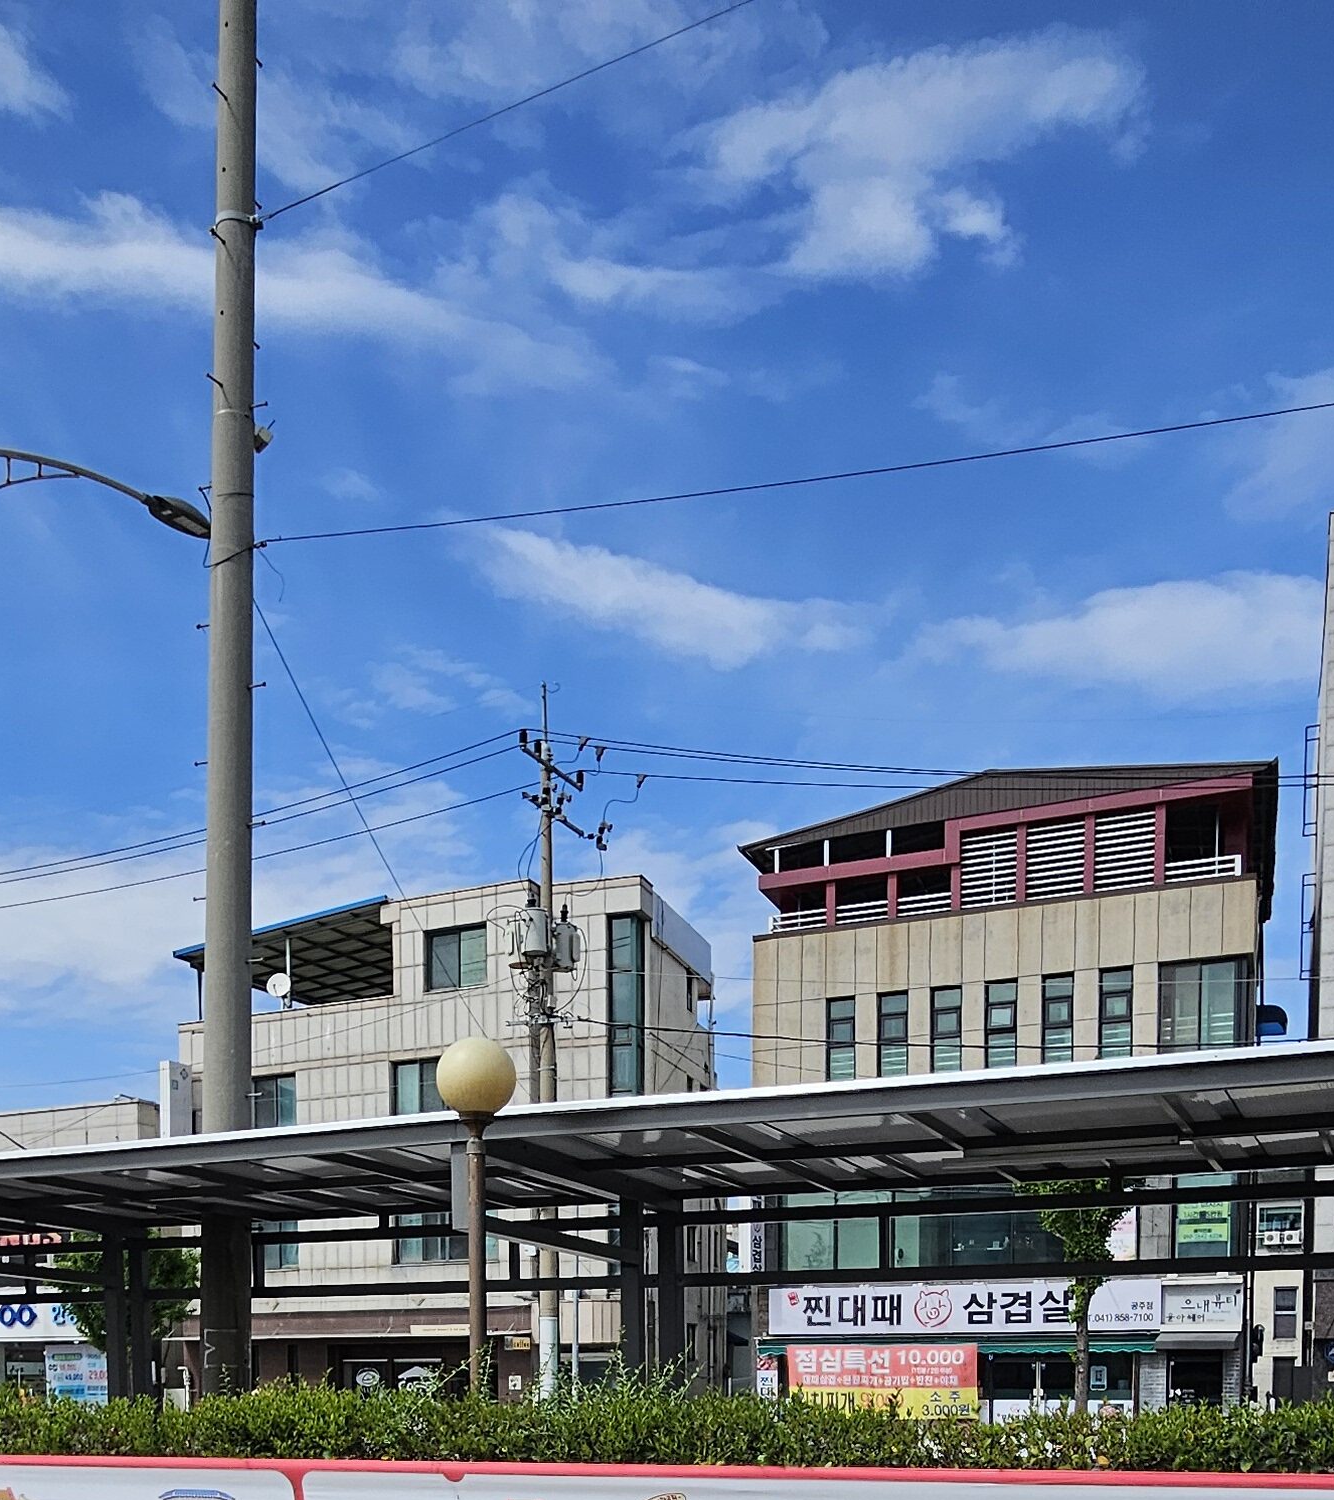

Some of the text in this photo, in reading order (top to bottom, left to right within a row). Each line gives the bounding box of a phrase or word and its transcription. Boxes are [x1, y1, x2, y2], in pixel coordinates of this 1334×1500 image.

[803, 1294, 902, 1326] 찐대패
[963, 1291, 1073, 1324] 삼겹살
[1131, 1302, 1153, 1310] 공주점
[1114, 1313, 1153, 1322] 858-7100
[795, 1350, 965, 1373] 점심특선 10.000
